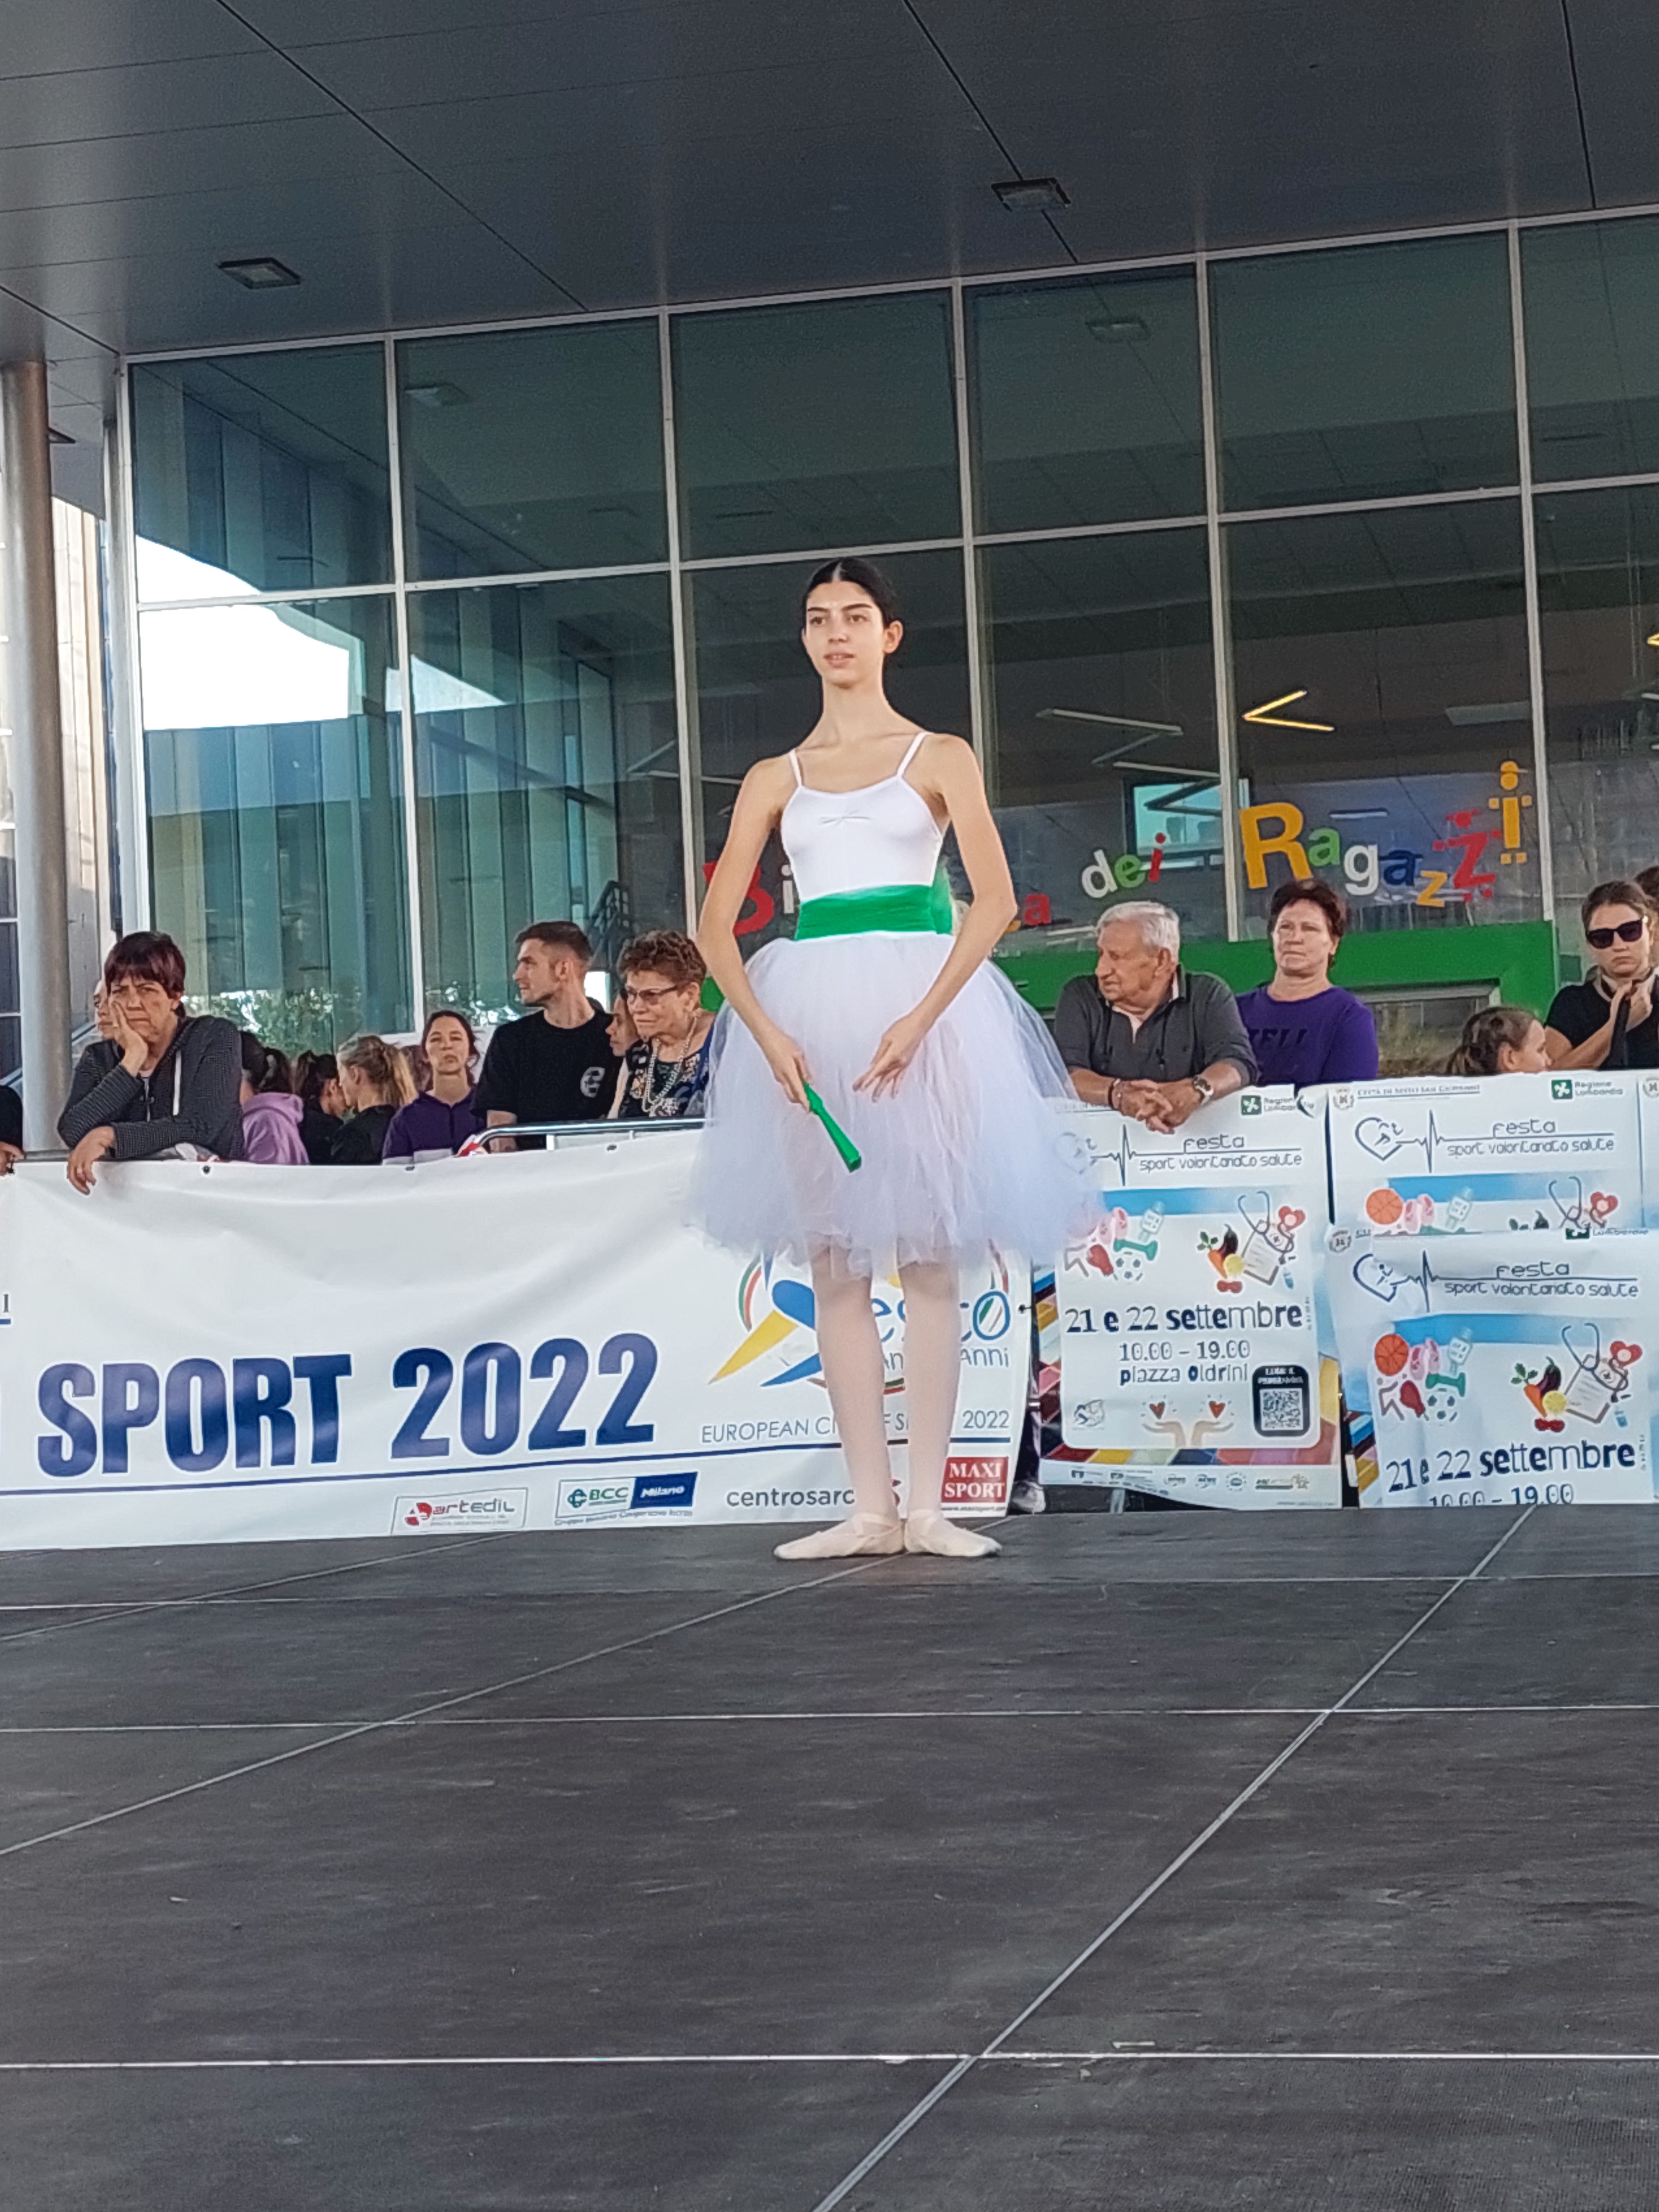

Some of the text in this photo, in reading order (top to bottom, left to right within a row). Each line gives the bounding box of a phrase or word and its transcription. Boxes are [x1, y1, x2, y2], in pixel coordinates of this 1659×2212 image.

[1082, 832, 1166, 898] dei
[1448, 1142, 1484, 1158] sport
[1572, 1139, 1614, 1151] salute
[1140, 1158, 1174, 1173] sport
[1261, 1154, 1302, 1166] salute
[1445, 1282, 1638, 1297] sport volontariato salute
[1065, 1308, 1098, 1333] 21
[1104, 1311, 1118, 1332] e
[1126, 1305, 1158, 1331] 22
[1166, 1301, 1303, 1330] settembre
[1119, 1342, 1172, 1361] 10.00
[1196, 1340, 1250, 1359] 19.00
[1120, 1367, 1180, 1385] piazza
[38, 1333, 658, 1477] SPORT 2022
[702, 1419, 809, 1443] EUROPEAN
[962, 1410, 1009, 1429] 2022
[949, 1463, 1003, 1478] MAXI
[1386, 1458, 1417, 1492] 21
[1420, 1459, 1429, 1484] e
[1436, 1449, 1471, 1481] 22
[1480, 1439, 1635, 1477] settembre
[589, 1485, 685, 1501] BCC Milano
[726, 1487, 855, 1507] centrosarc
[944, 1482, 1005, 1498] SPORT
[1511, 1483, 1574, 1505] 19.00
